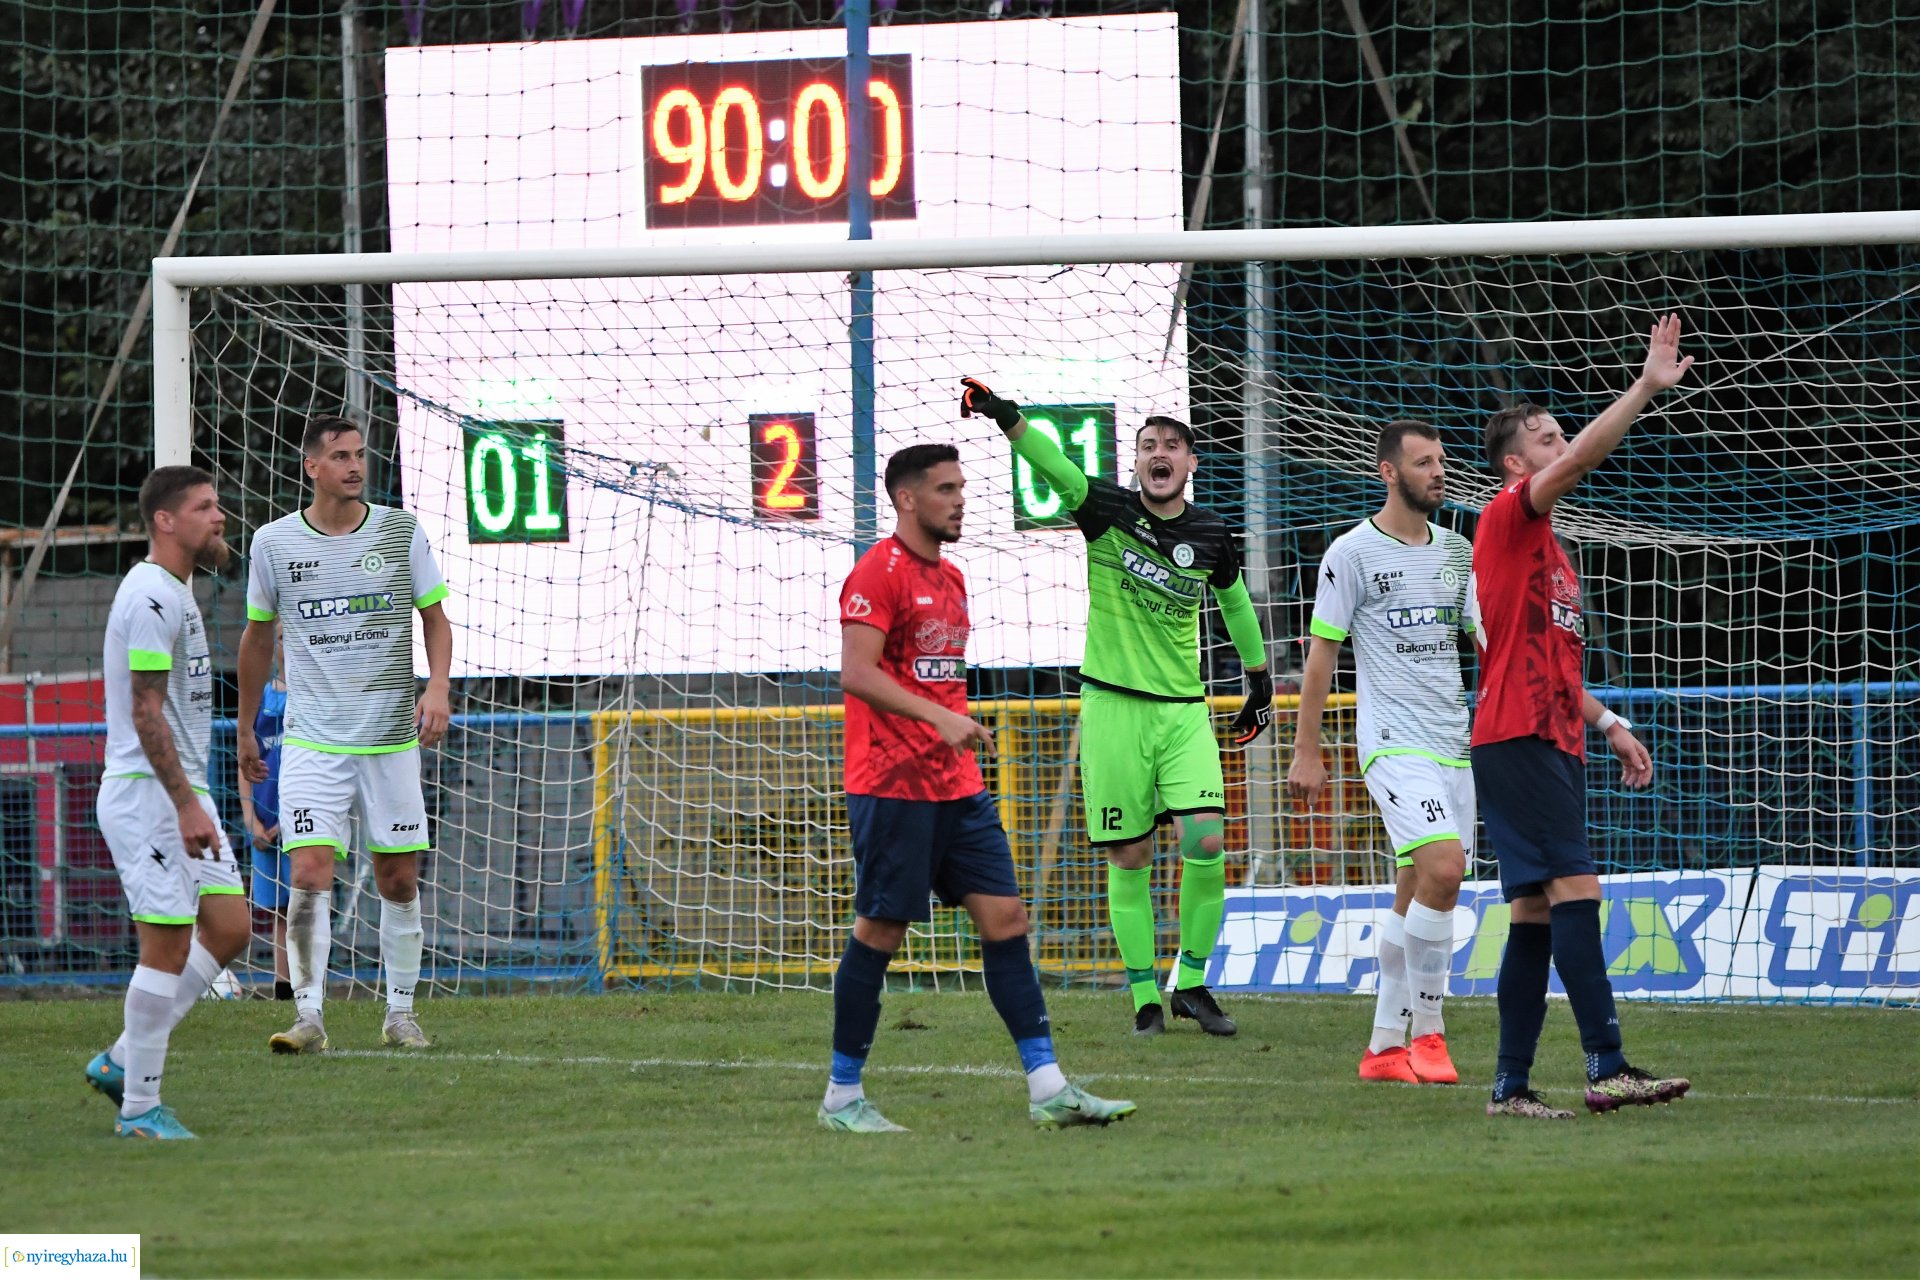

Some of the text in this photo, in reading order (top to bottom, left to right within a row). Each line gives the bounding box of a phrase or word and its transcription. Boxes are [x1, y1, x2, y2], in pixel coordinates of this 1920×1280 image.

[764, 423, 805, 508] 2
[471, 432, 561, 532] 01
[288, 560, 320, 570] Zeus
[1373, 571, 1404, 582] Zeus
[309, 631, 352, 646] Bakonyi
[293, 808, 314, 834] 25
[1101, 806, 1122, 831] 12
[1421, 798, 1446, 823] 34
[391, 823, 420, 832] Zeus
